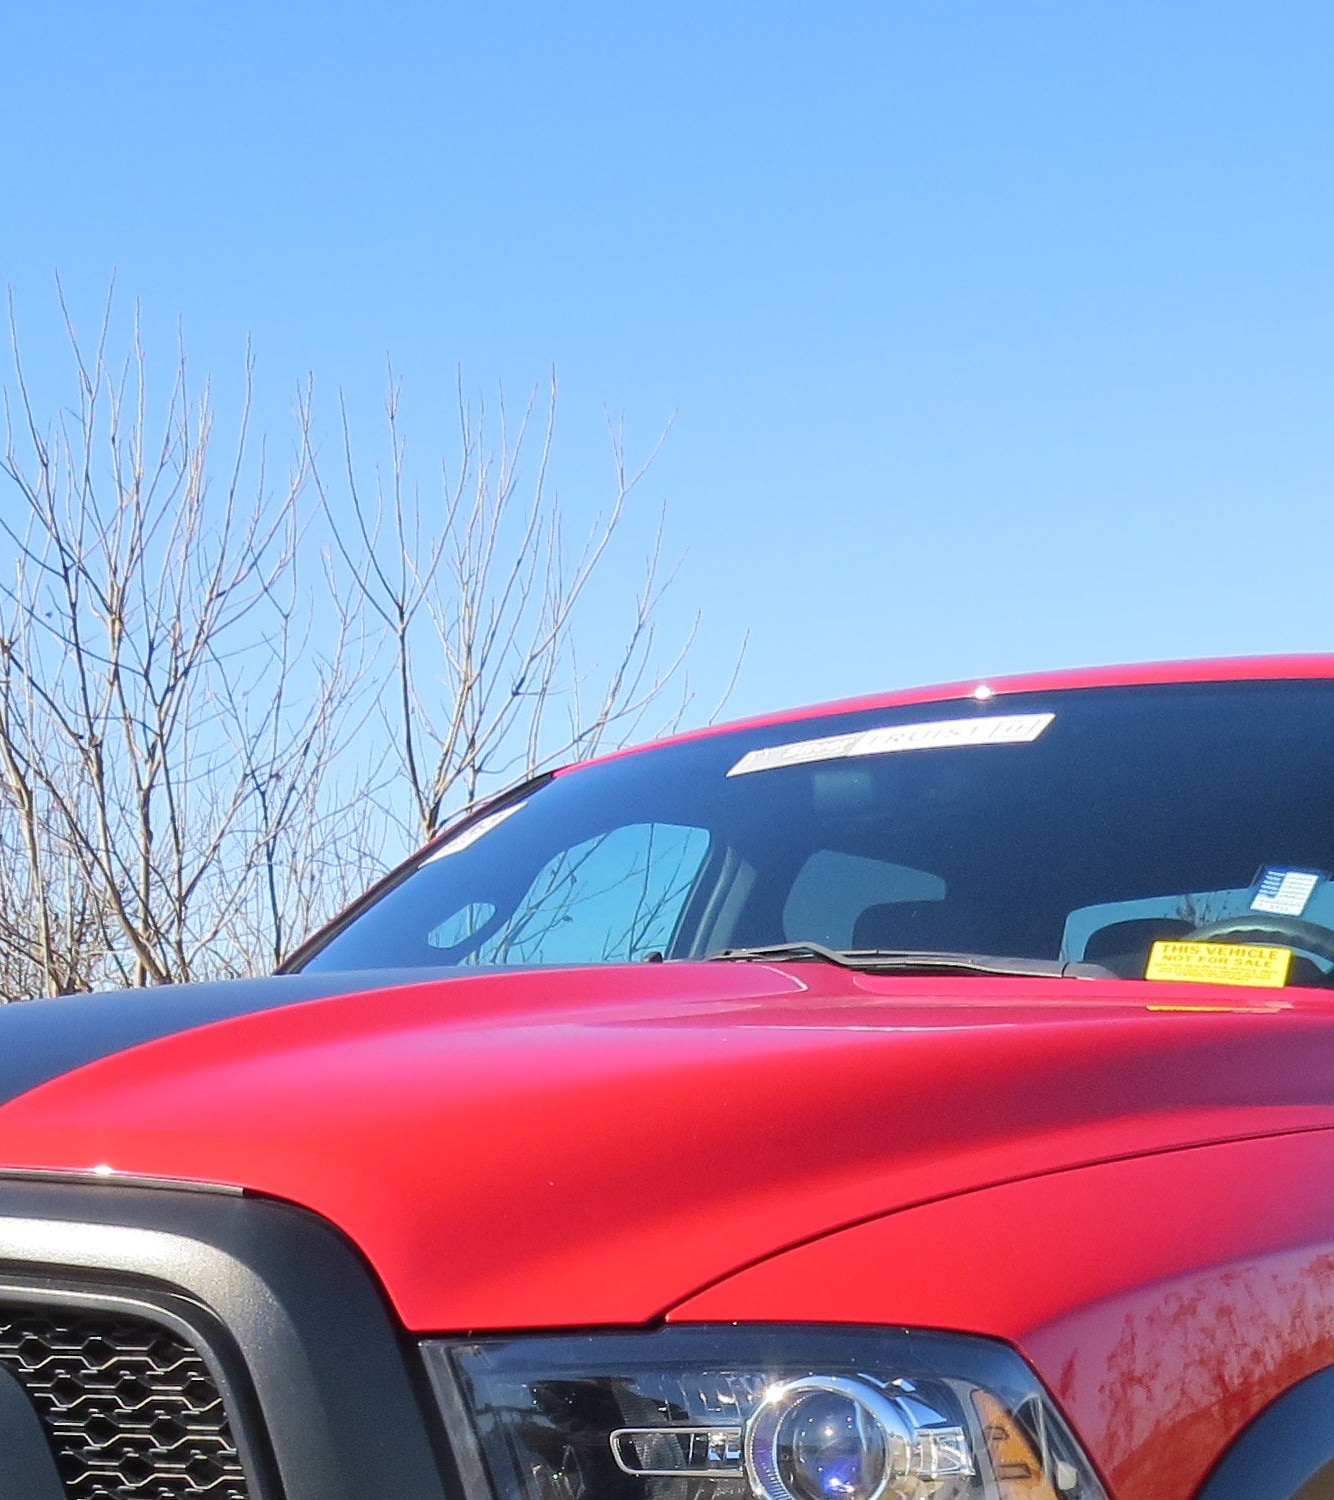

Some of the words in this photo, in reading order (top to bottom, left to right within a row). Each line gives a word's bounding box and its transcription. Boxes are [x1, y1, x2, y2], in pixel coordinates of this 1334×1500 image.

[1162, 944, 1200, 955] THIS
[1206, 946, 1279, 960] VEHICLE
[1198, 956, 1229, 964] FOR
[1234, 958, 1273, 968] SALE
